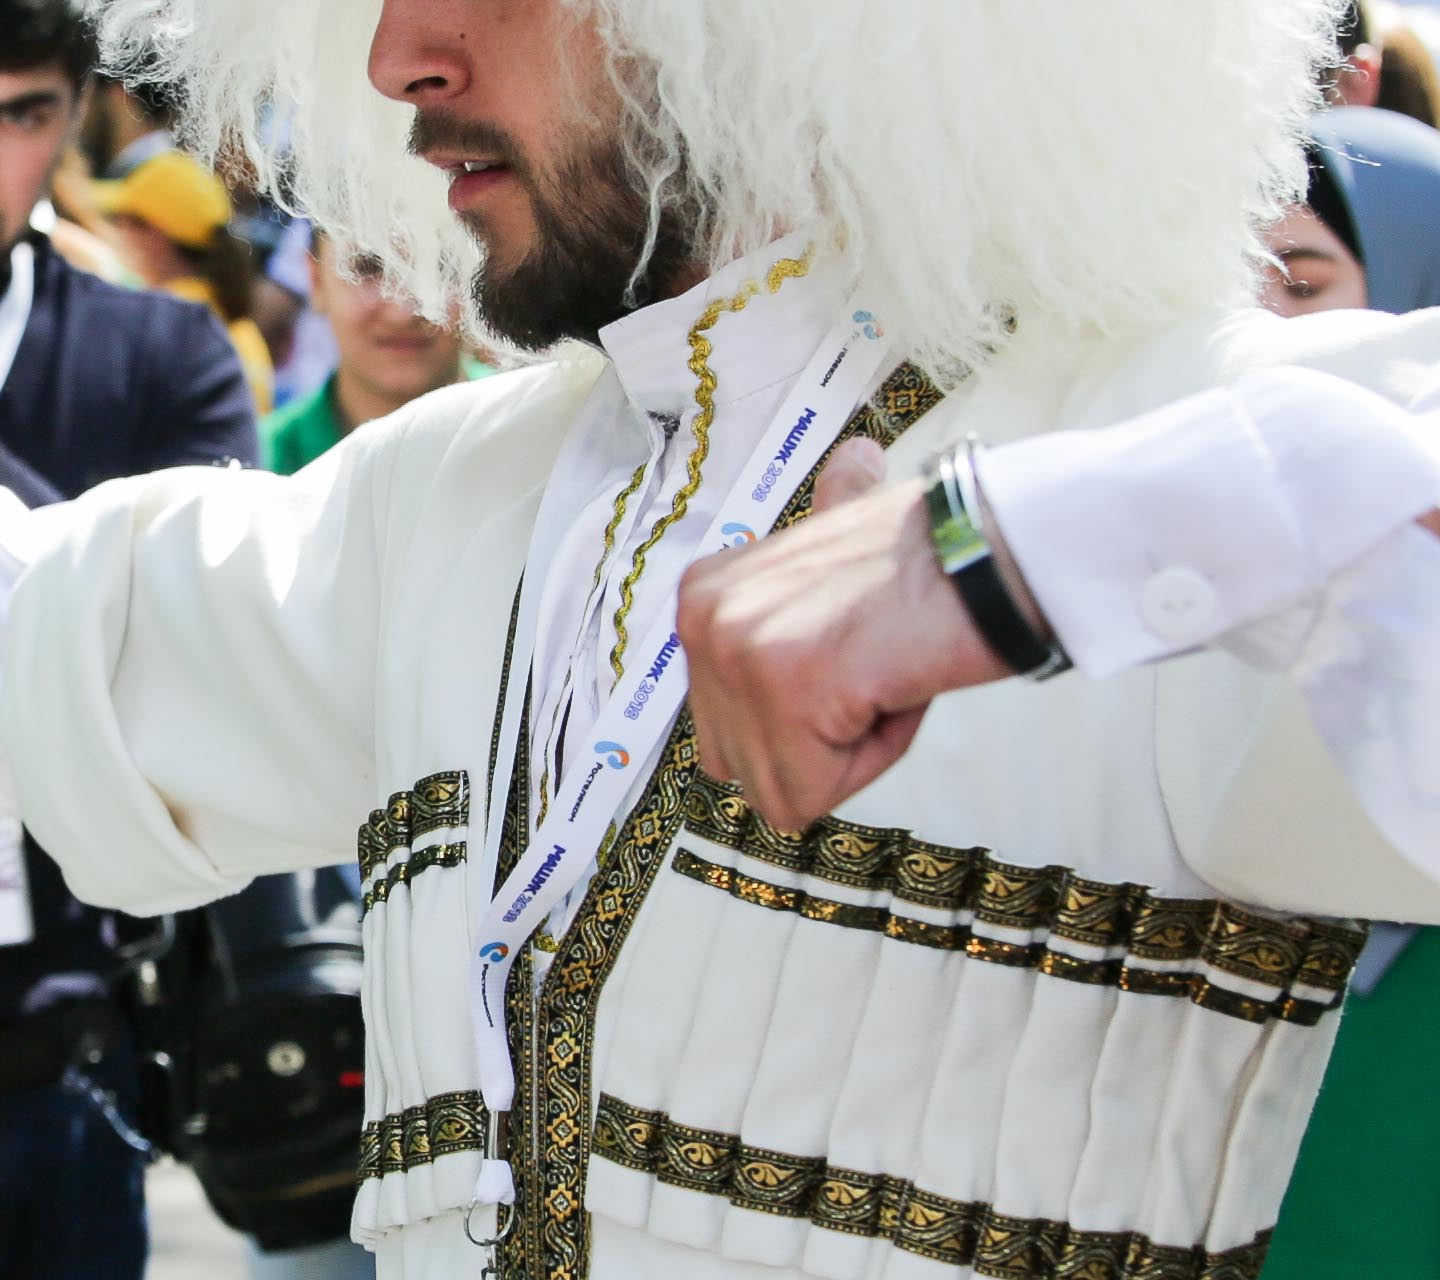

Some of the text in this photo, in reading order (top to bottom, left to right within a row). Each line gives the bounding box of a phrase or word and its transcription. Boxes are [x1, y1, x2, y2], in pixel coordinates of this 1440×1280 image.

[752, 407, 817, 502] МАШУК 2018
[624, 632, 681, 720] АШУК 2018
[523, 844, 566, 895] МАШУК
